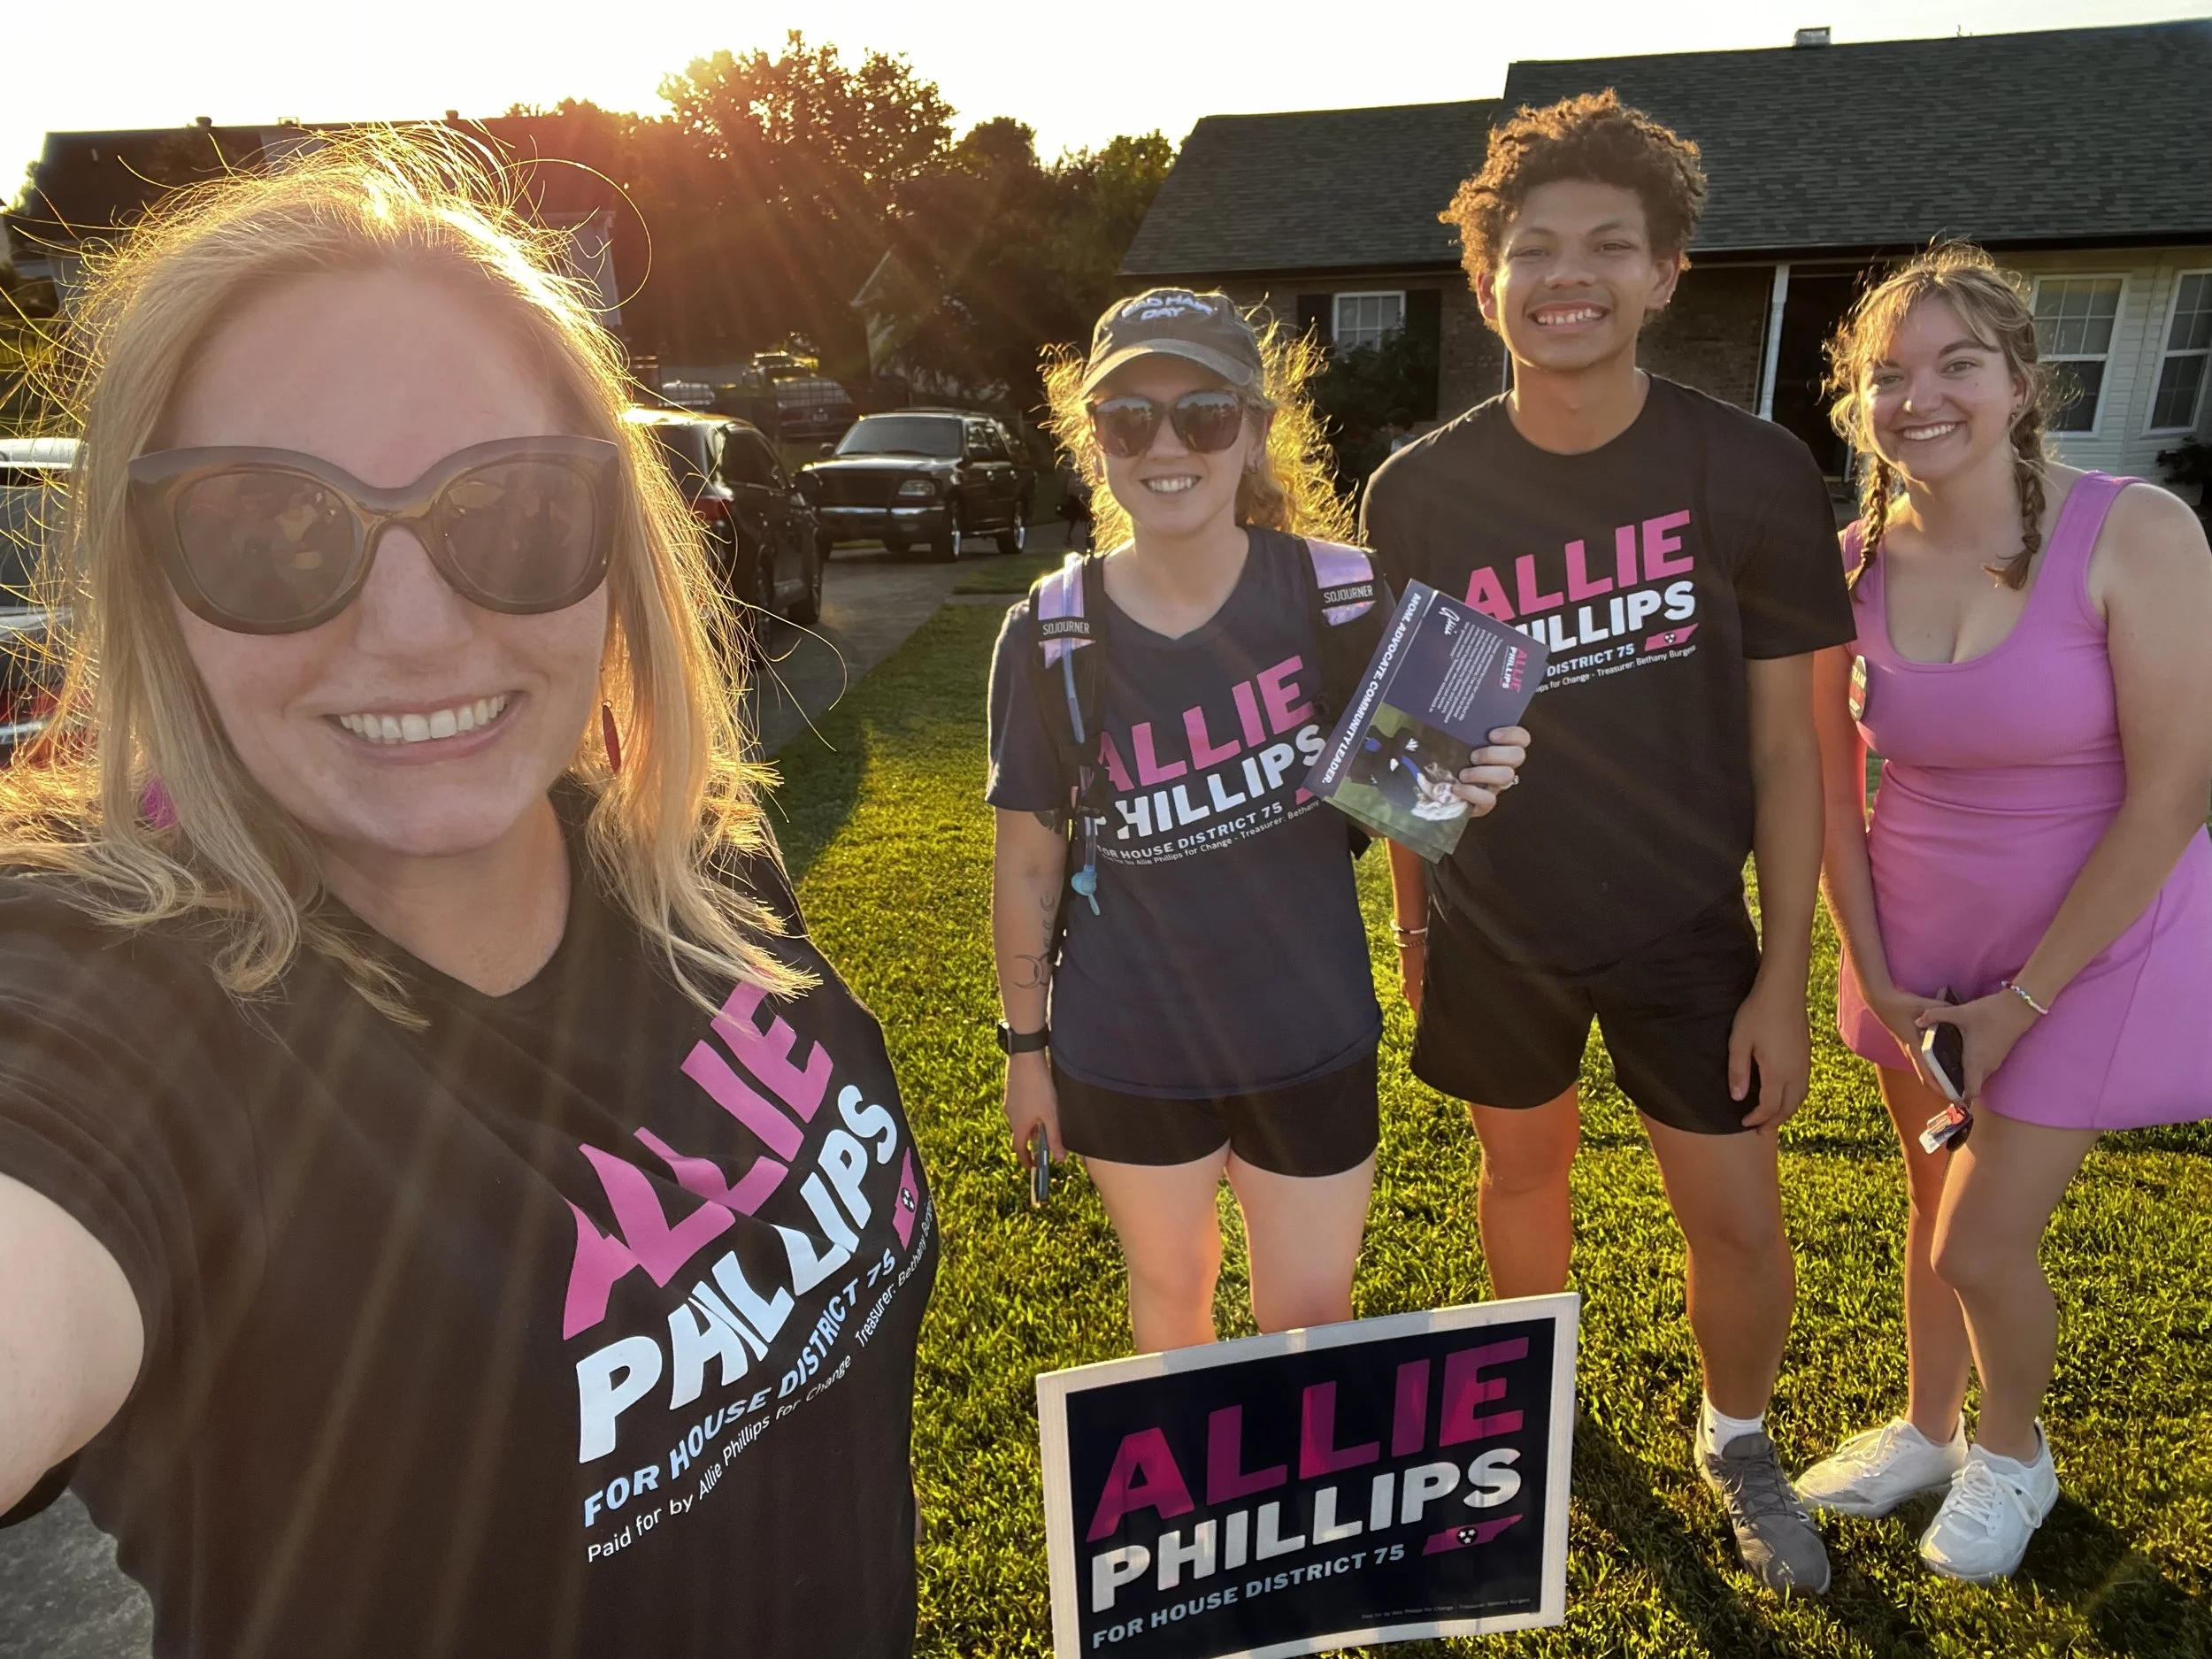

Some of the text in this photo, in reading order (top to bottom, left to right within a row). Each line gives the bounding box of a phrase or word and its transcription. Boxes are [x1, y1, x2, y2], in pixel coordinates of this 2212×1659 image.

[1323, 584, 1374, 604] SOJOURNER
[1464, 510, 1694, 622] ALLIE
[1041, 620, 1091, 636] SOJOURNER
[1502, 647, 1517, 690] PHILLIPS
[1509, 648, 1528, 693] ALLIE
[1547, 642, 1636, 677] DISTRICT 75
[1563, 673, 1591, 686] Change
[1596, 660, 1636, 678] Treasurer:
[1636, 650, 1668, 666] Bethany
[1097, 655, 1315, 793] ALLIE
[1321, 592, 1422, 785] MOM. ADVOCATE. COMMUNITY LEADER.
[1120, 841, 1174, 859] HOUSE
[1177, 812, 1257, 849] DISTRICT
[1261, 802, 1283, 819] 75
[1154, 852, 1184, 864] Phillips
[1185, 846, 1198, 857] for
[1200, 837, 1233, 853] Change
[1240, 817, 1286, 840] Treasurer:
[1286, 800, 1320, 820] Bethany
[563, 973, 834, 1340] ALLIE
[576, 1084, 898, 1463] PHILLIPS
[583, 1248, 896, 1529] FOR HOUSE DISTRICT 75
[587, 1525, 632, 1564] Paid
[634, 1507, 662, 1536] for
[667, 1494, 695, 1521] by
[697, 1462, 723, 1502] Allie
[721, 1412, 771, 1470] Phillips
[774, 1395, 802, 1423] for
[805, 1353, 852, 1405] Change
[855, 1283, 896, 1348] Treasurer:
[898, 1235, 927, 1287] Bethany
[1087, 1336, 1530, 1544] ALLIE
[1091, 1448, 1523, 1614] PHILLIPS
[1092, 1544, 1405, 1650] FOR HOUSE DISTRICT 75
